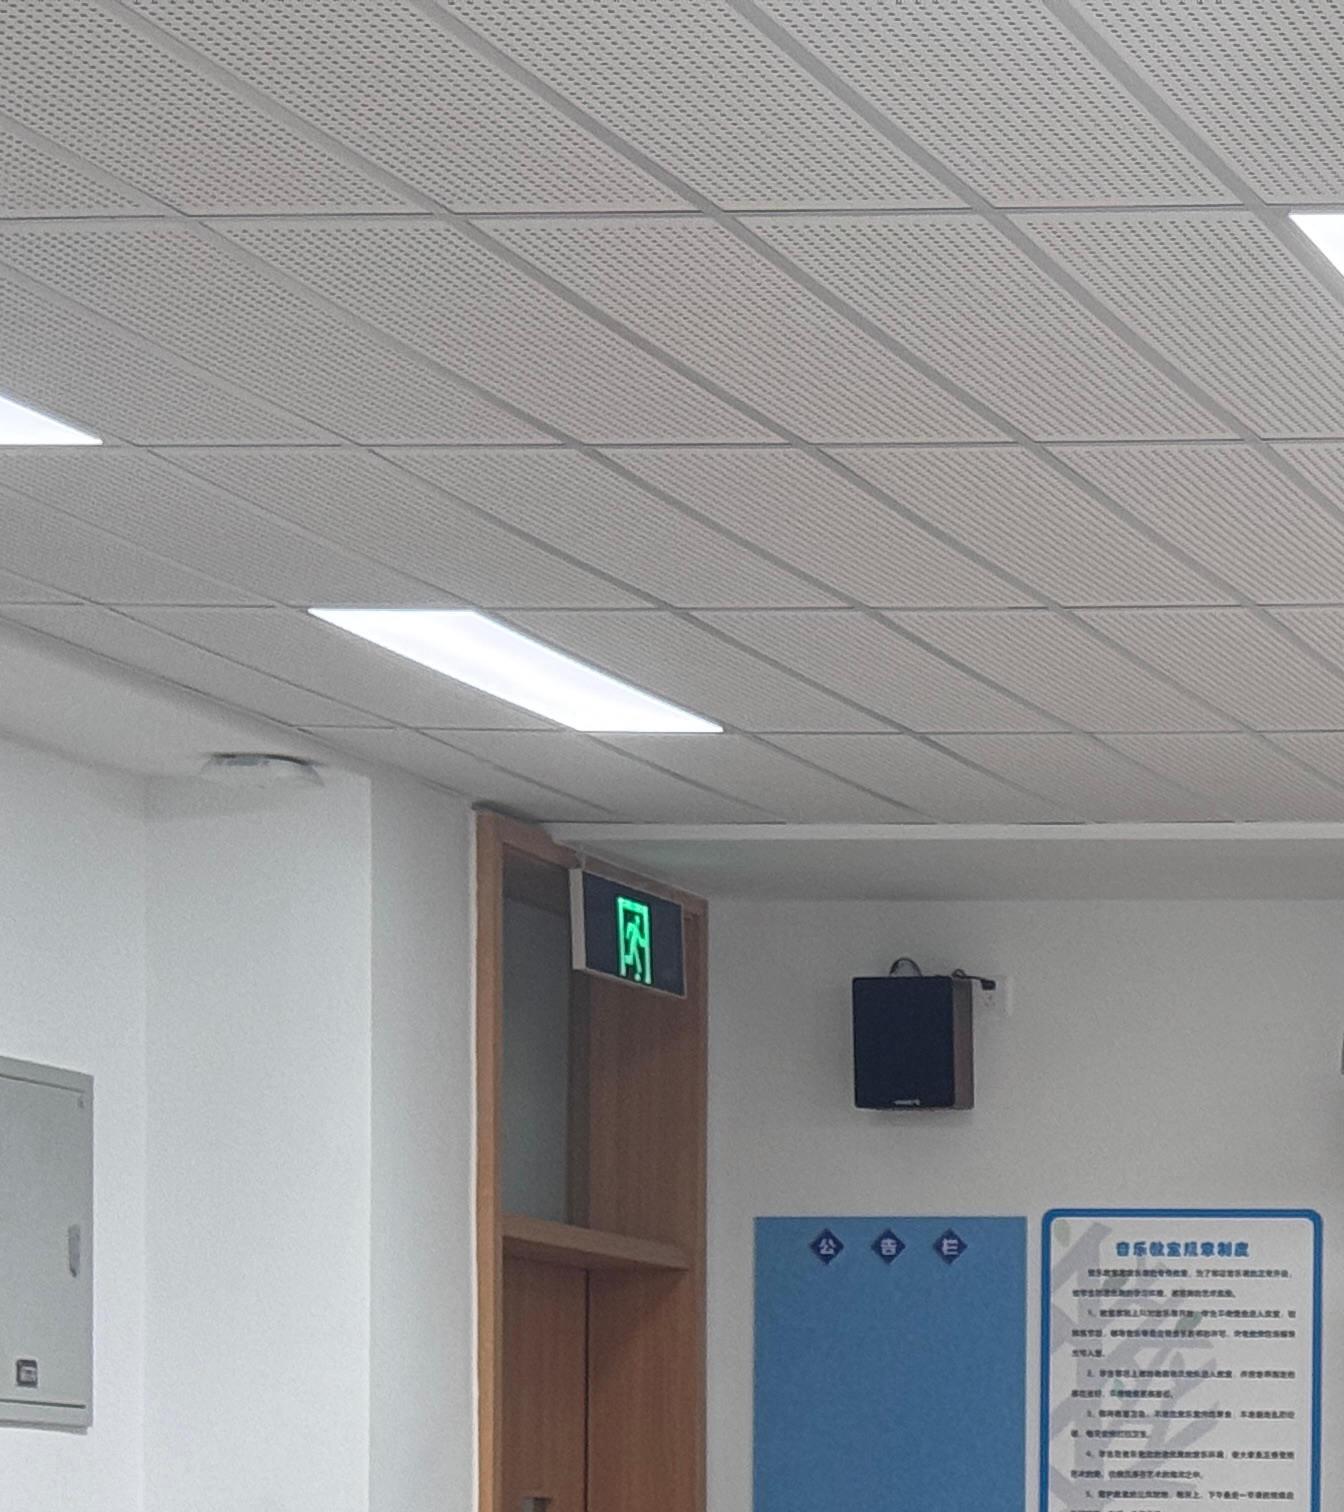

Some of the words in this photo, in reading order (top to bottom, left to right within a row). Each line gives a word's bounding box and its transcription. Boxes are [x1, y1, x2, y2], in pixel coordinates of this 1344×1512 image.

[818, 1237, 959, 1256] 公告栏
[1115, 1241, 1250, 1257] 音乐教室规章制度
